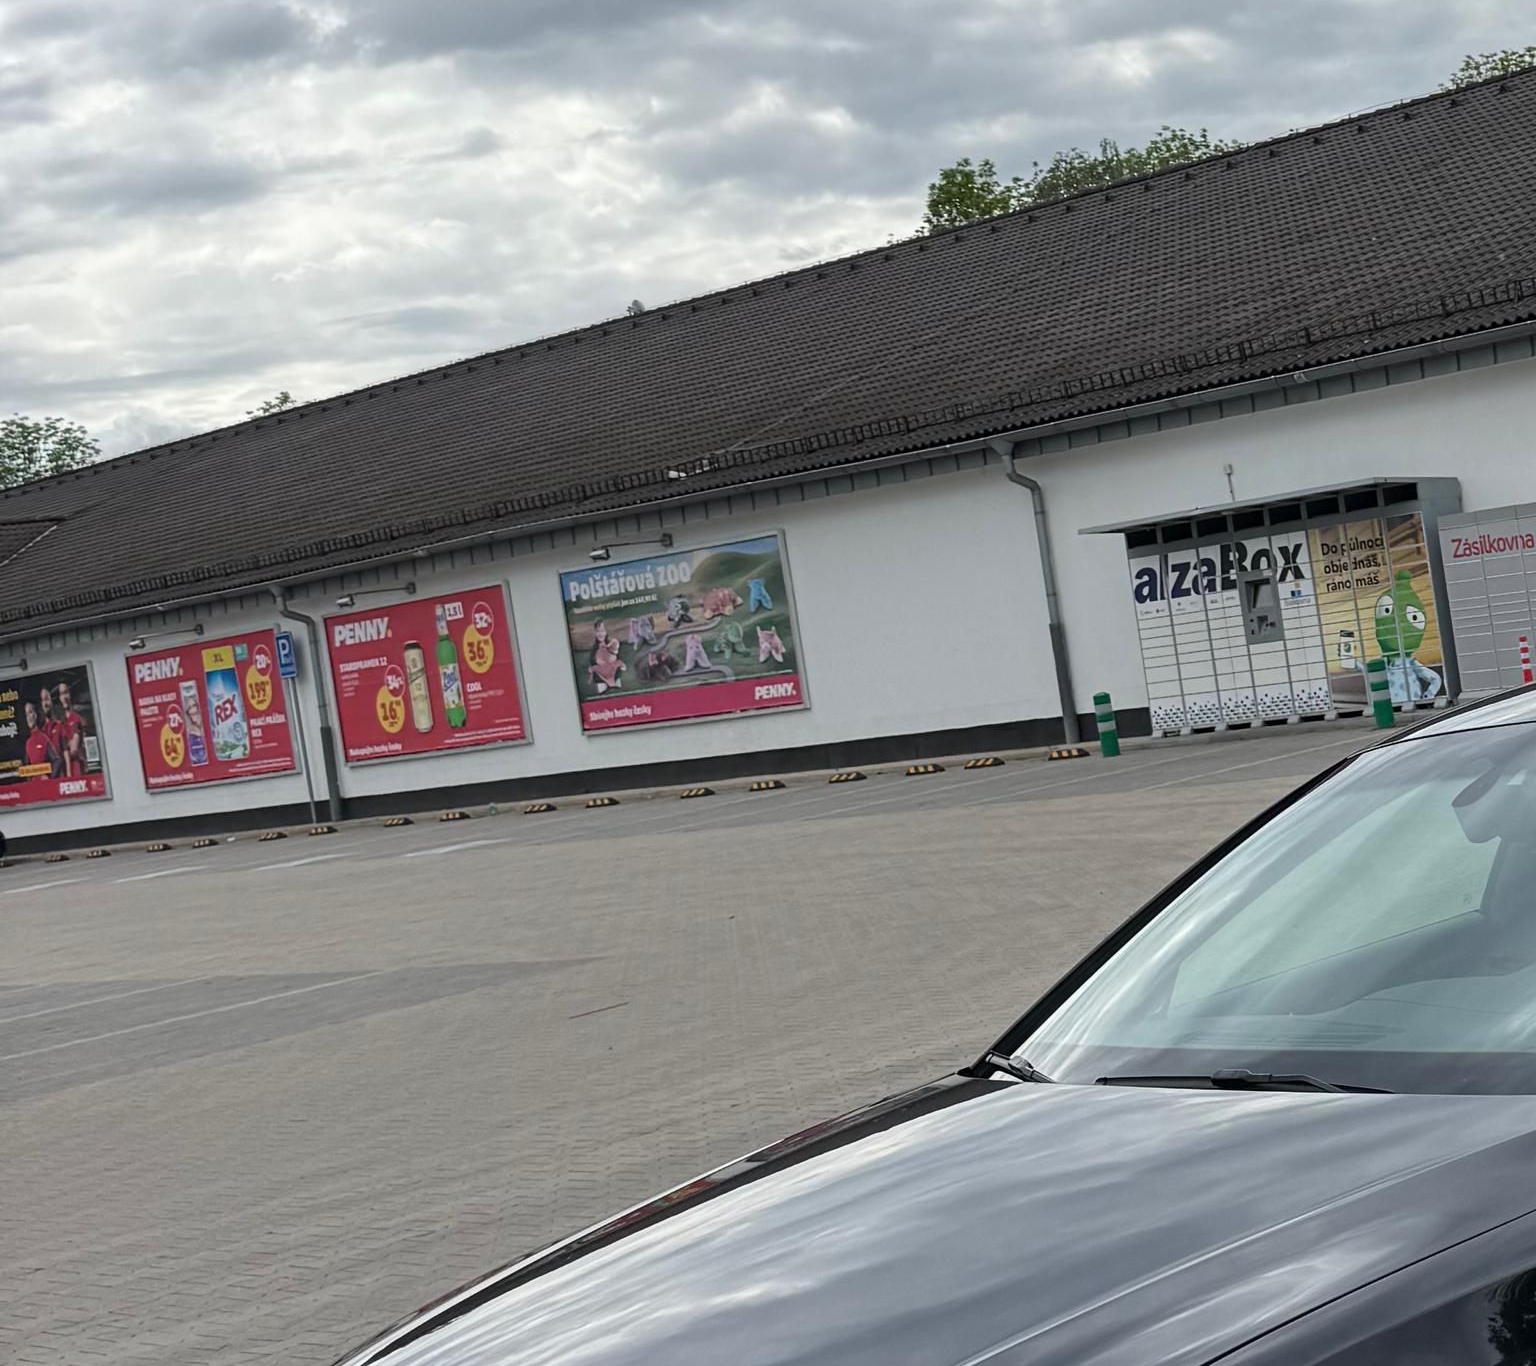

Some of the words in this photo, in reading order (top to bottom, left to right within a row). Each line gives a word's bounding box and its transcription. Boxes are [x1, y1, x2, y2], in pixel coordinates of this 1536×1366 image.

[1321, 542, 1338, 556] Do
[1451, 533, 1535, 559] Zásilkovna
[569, 565, 655, 602] Polštářová
[656, 561, 692, 586] ZOO
[1134, 541, 1305, 605] alzaBox
[1326, 577, 1352, 593] ráno
[1356, 571, 1380, 587] máš
[278, 639, 290, 664] P
[214, 694, 238, 725] REX
